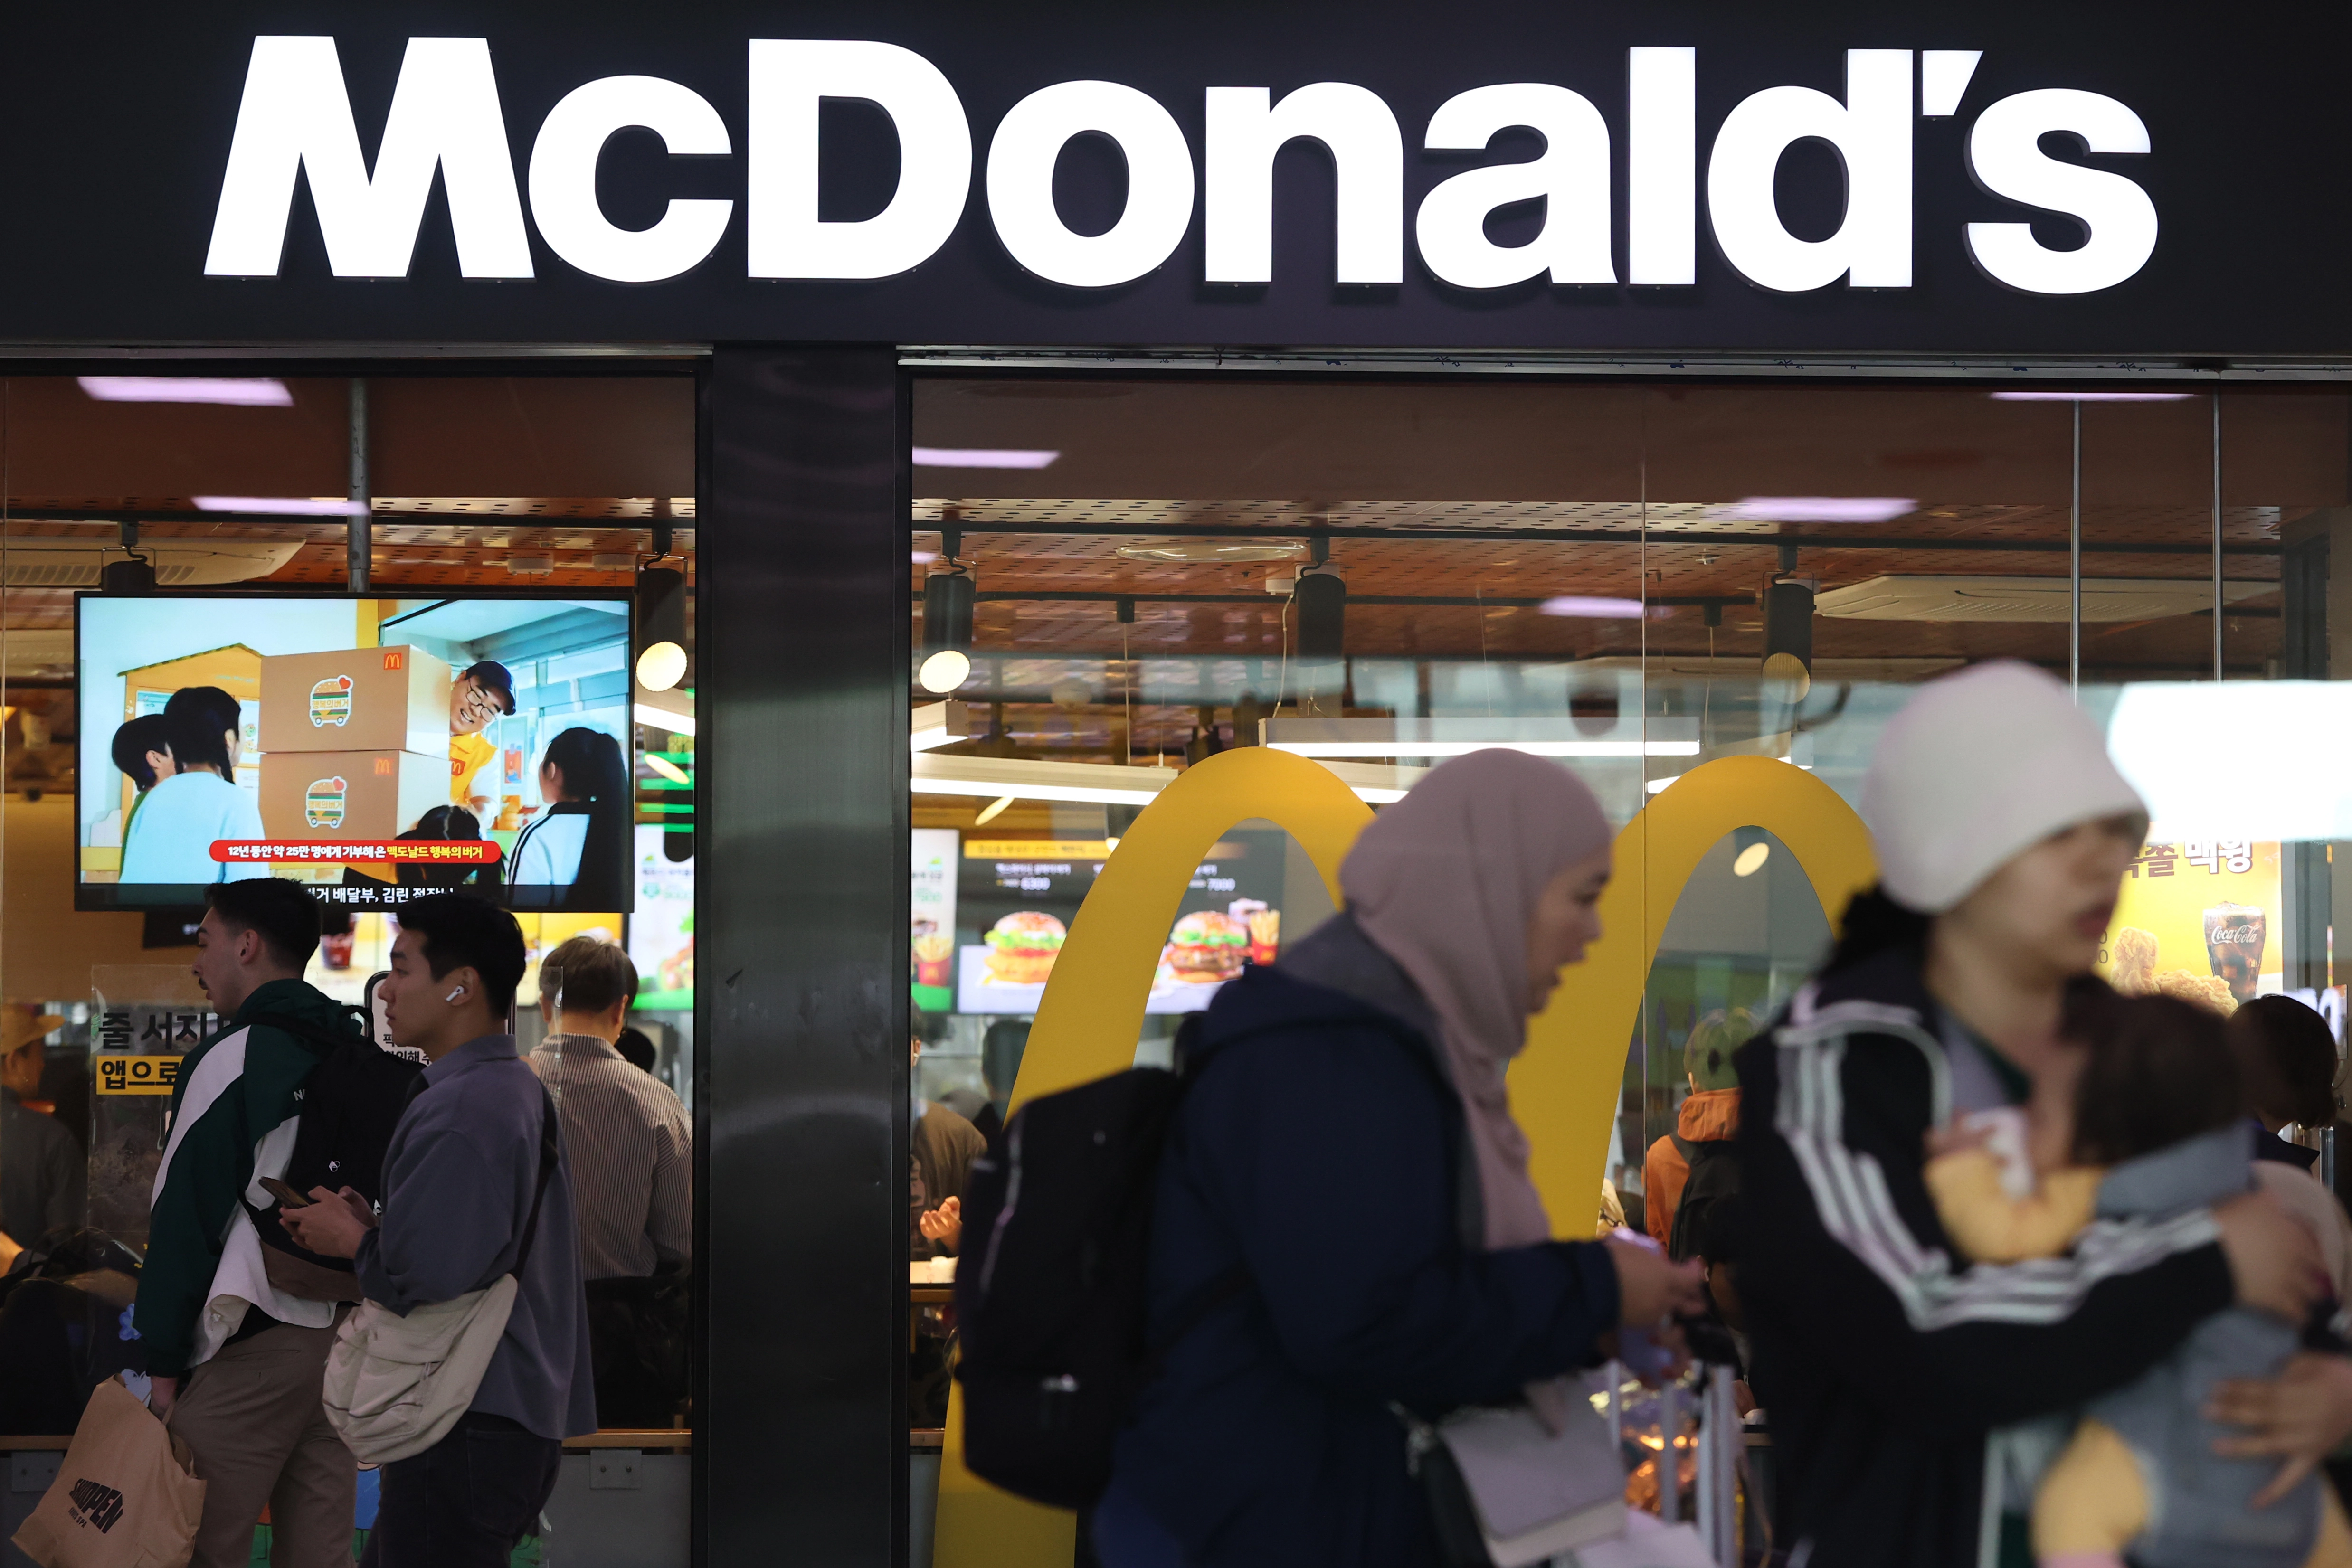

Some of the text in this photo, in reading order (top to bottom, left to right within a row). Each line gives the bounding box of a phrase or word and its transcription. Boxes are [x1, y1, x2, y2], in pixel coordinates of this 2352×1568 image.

[204, 36, 2158, 294] McDonald's
[228, 845, 249, 858] 12년
[250, 845, 272, 858] 동안
[273, 845, 285, 858] 약
[286, 846, 310, 858] 25만
[310, 846, 342, 858] 명에게
[387, 846, 429, 859] 맥도날드
[429, 846, 461, 859] 행복의
[462, 846, 483, 859] 버거
[333, 887, 379, 903] 배달부,
[382, 888, 409, 903] 김린
[99, 1013, 134, 1049] 줄
